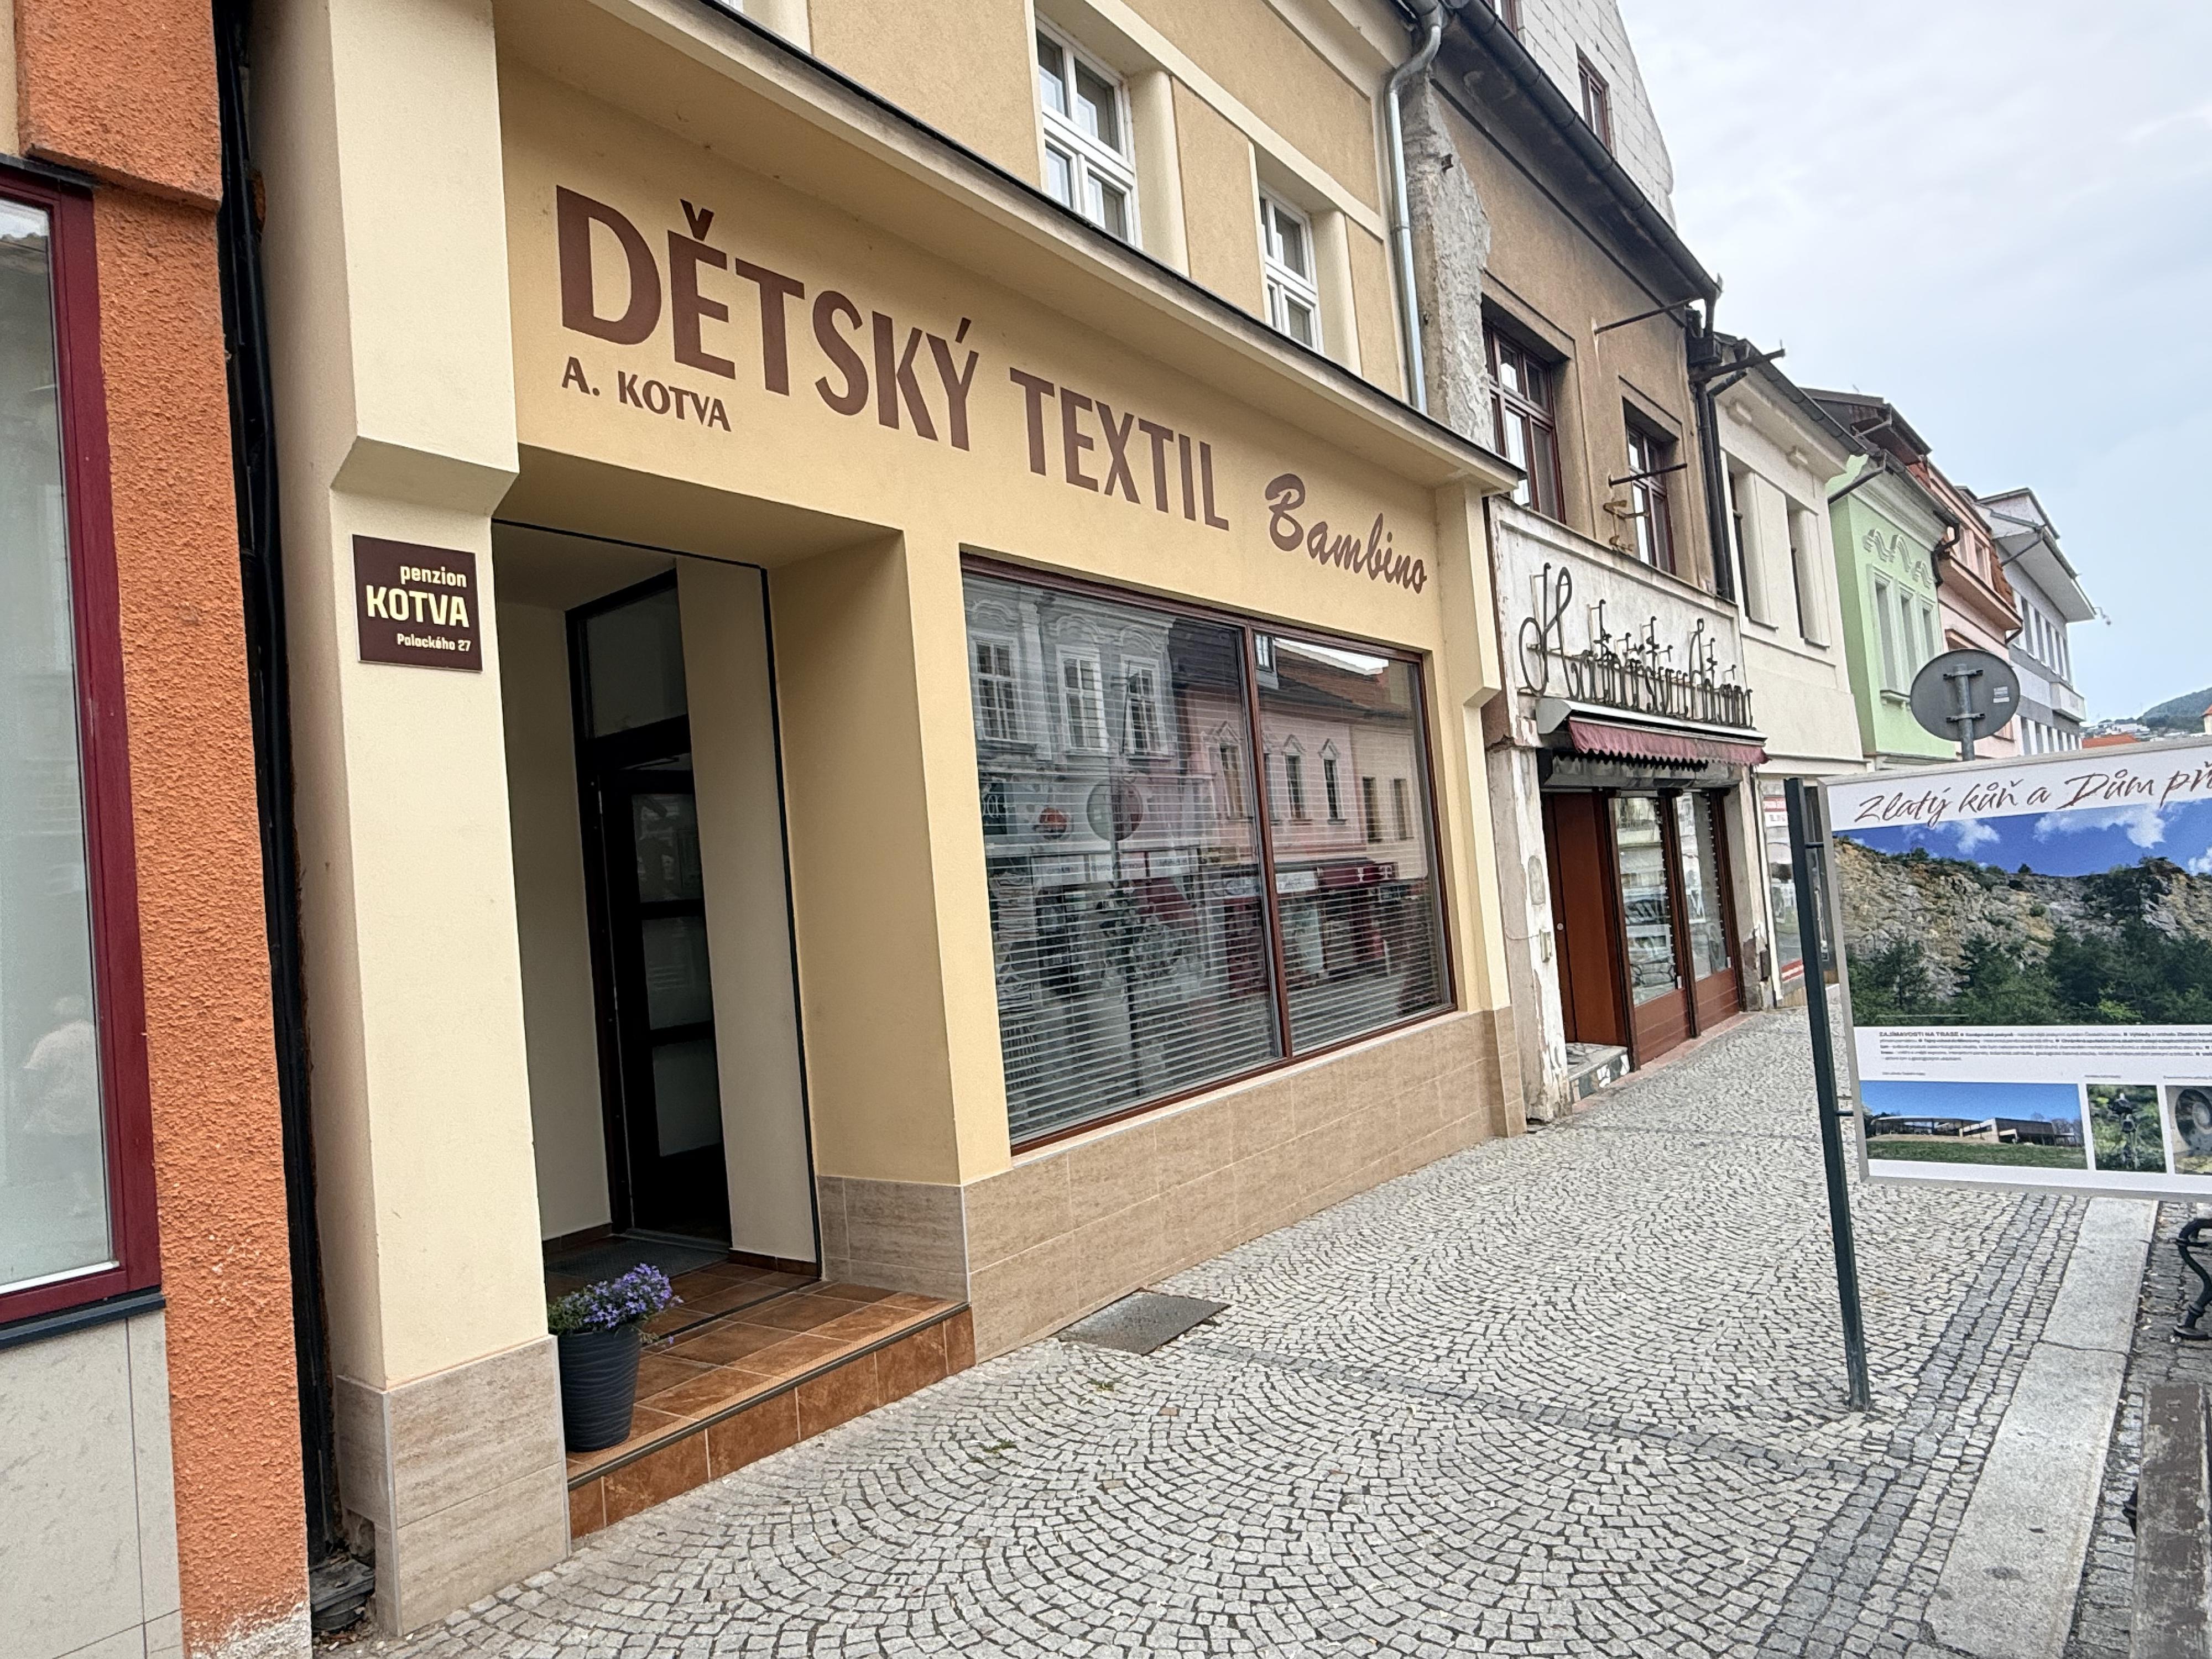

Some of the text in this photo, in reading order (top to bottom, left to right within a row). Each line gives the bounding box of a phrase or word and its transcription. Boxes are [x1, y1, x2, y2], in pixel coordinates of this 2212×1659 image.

[556, 185, 1427, 594] DĚTSKÝ TEXTIL Bambino
[562, 357, 732, 432] A. KOTVA
[400, 566, 467, 587] penzion
[366, 585, 469, 628] KOTVA
[397, 633, 472, 651] Palackého 27
[1854, 787, 1952, 827] Zlatý
[1958, 779, 2024, 813] kůň
[2026, 786, 2052, 805] a
[2056, 769, 2154, 810] Dům
